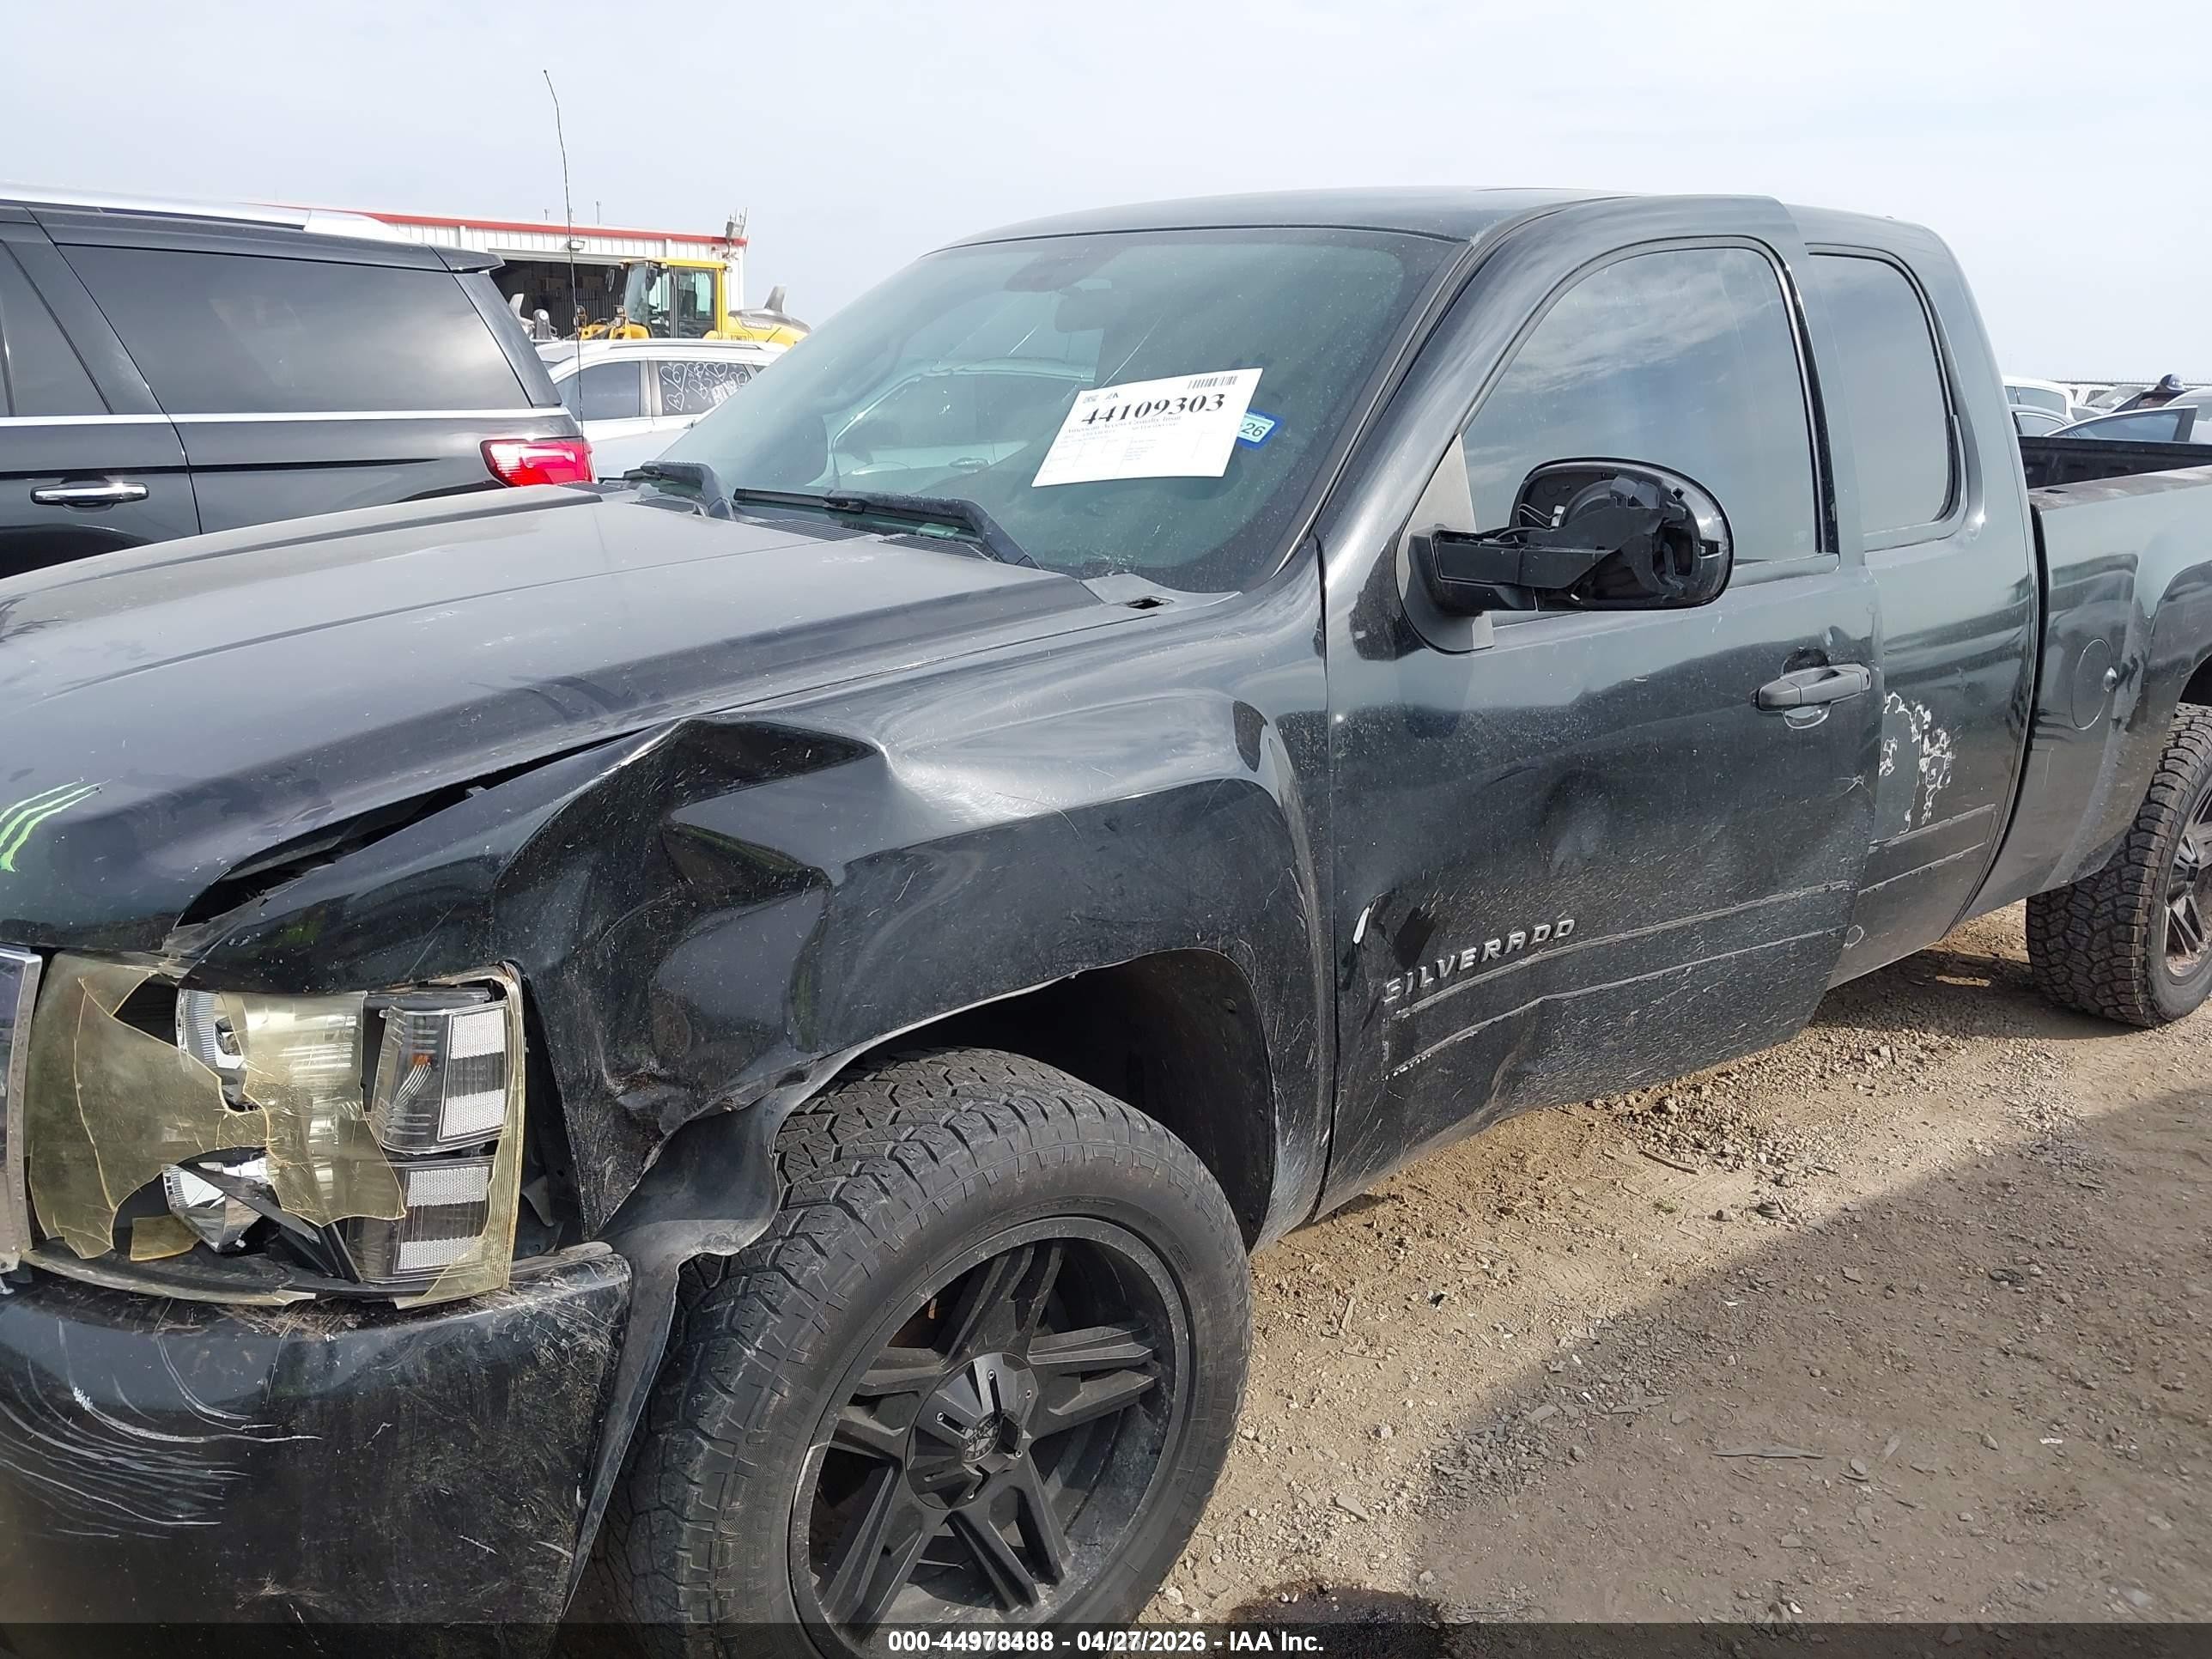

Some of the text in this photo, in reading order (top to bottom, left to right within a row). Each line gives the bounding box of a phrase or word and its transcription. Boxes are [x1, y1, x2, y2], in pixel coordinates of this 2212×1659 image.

[1081, 393, 1225, 425] 44109303
[1241, 422, 1267, 437] 26
[1382, 919, 1576, 1004] SILVERADO
